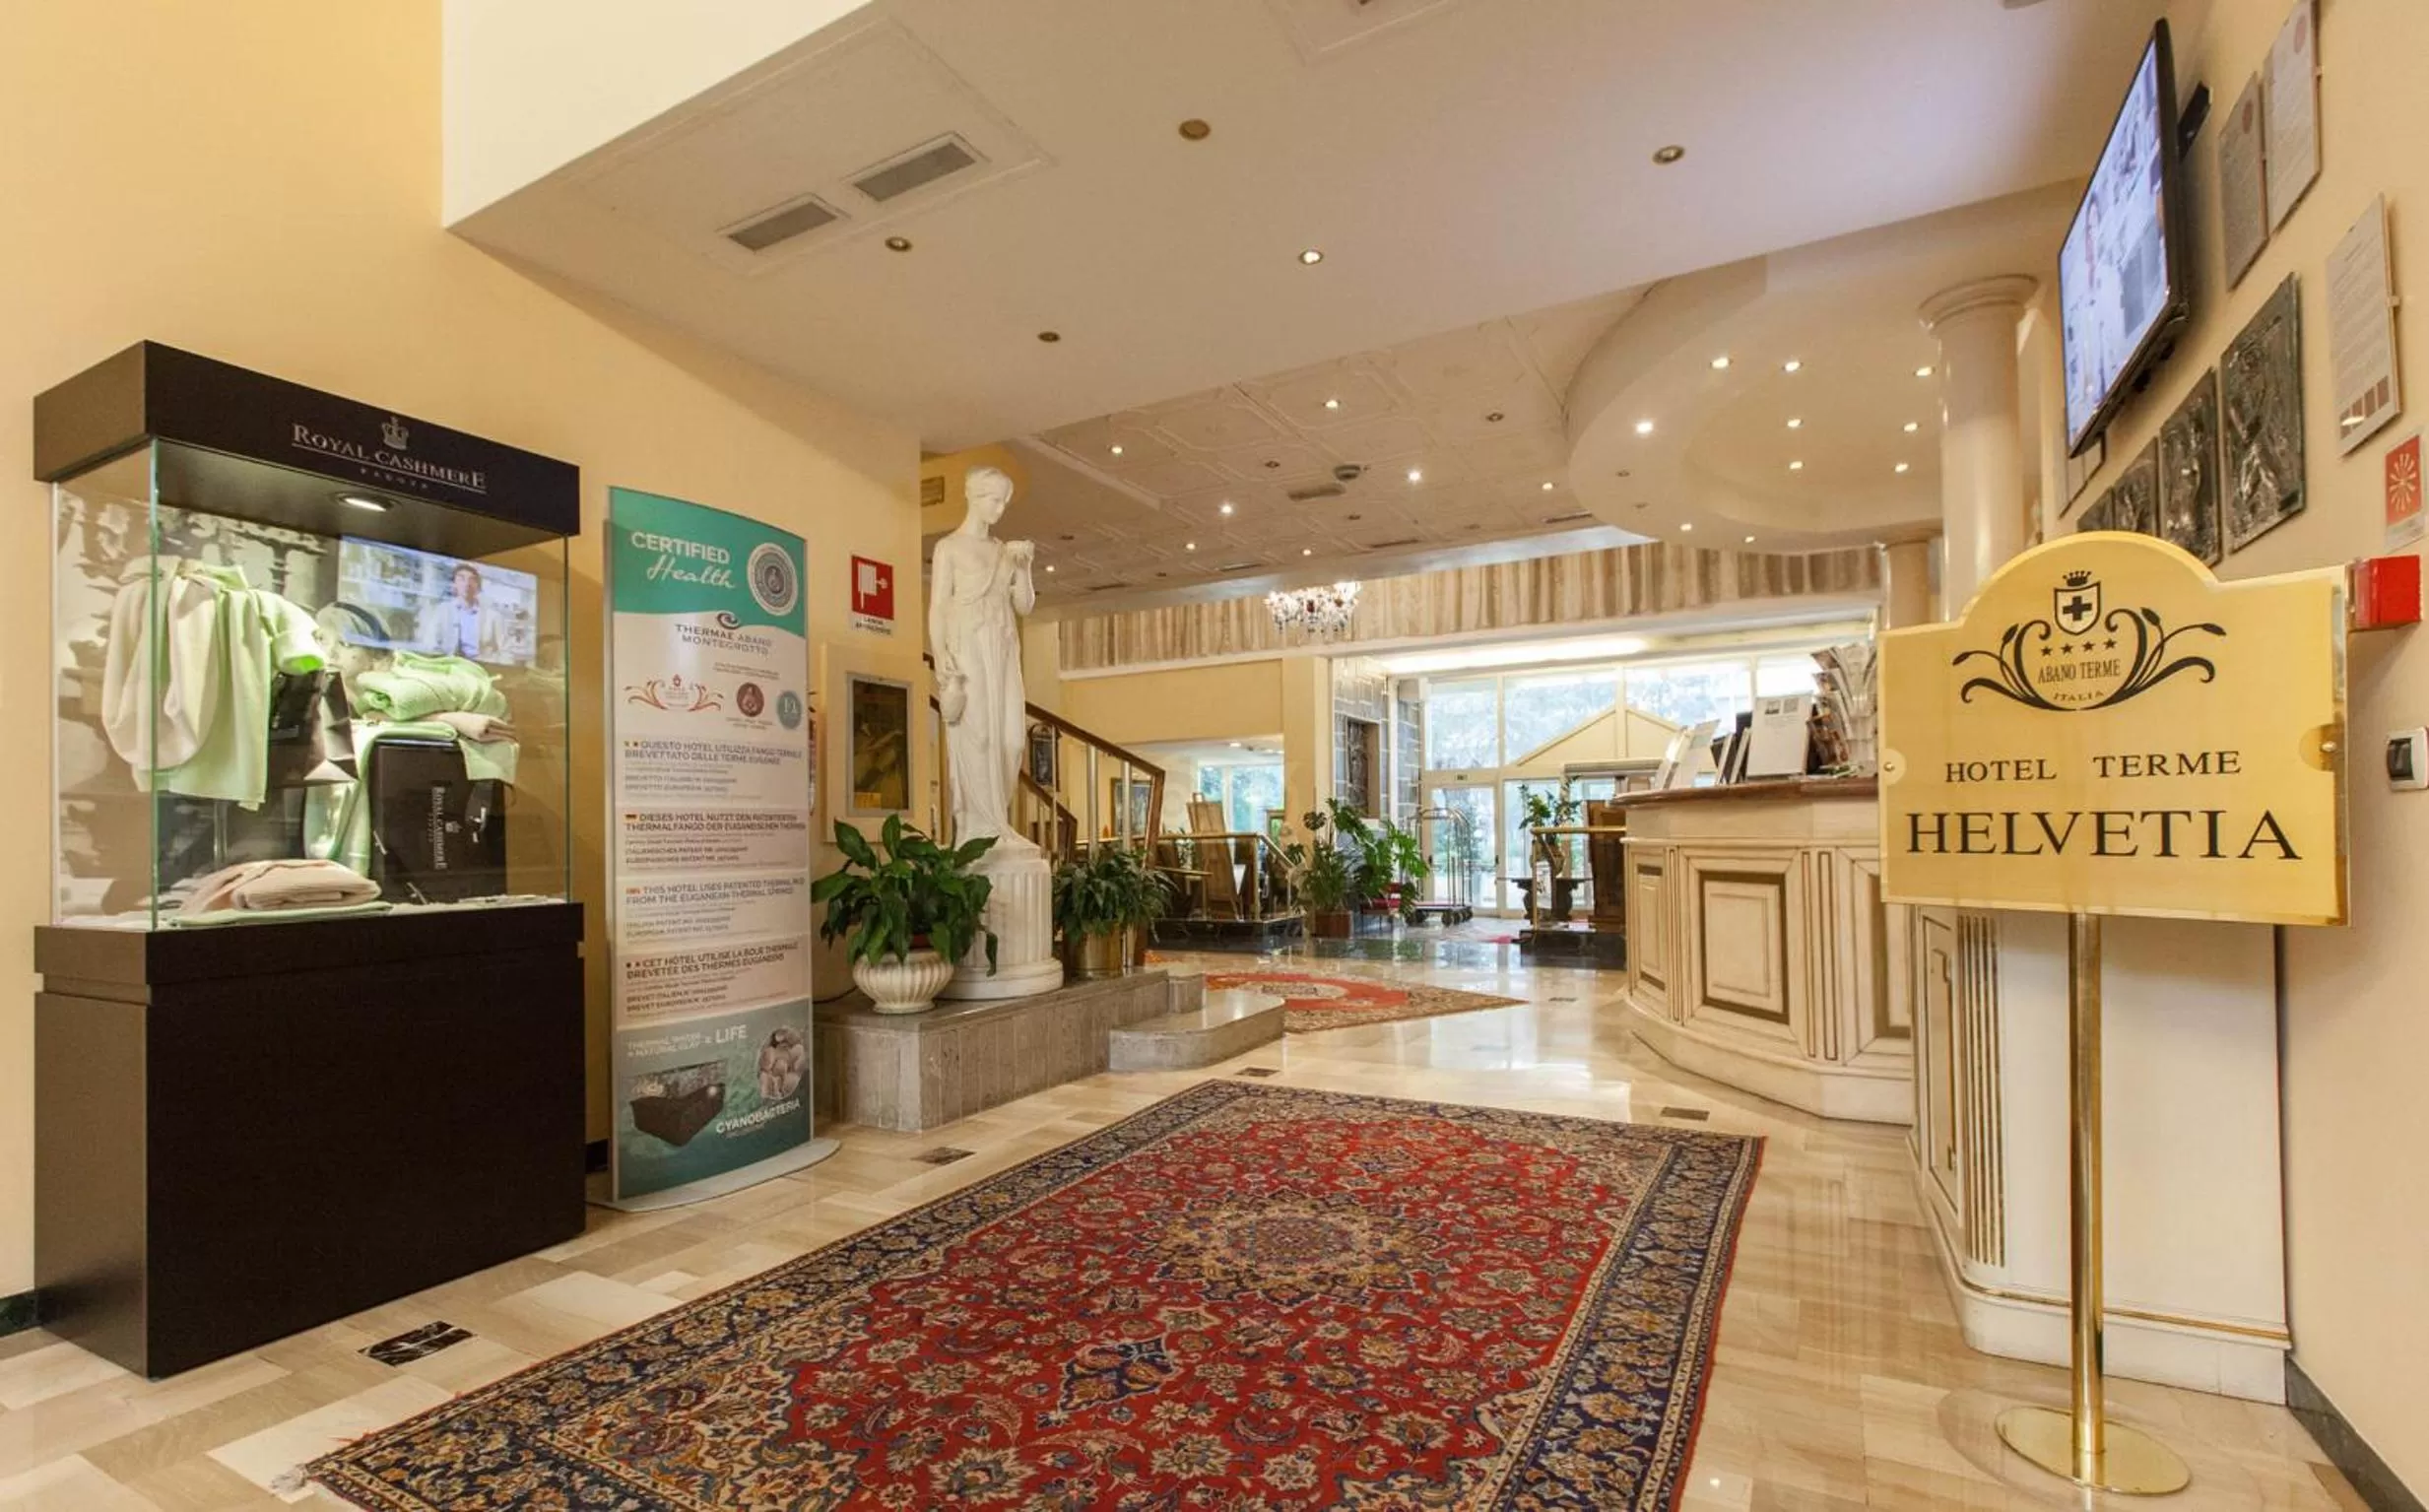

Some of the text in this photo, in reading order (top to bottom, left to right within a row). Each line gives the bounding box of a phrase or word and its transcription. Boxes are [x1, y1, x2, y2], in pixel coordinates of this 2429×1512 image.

[292, 424, 487, 490] ROYAL CASHMERE
[631, 532, 730, 564] CERTIFIED
[646, 554, 737, 589] Health
[674, 624, 735, 640] THERMAE
[2038, 658, 2121, 684] ABANO TERME
[2053, 690, 2105, 702] ITALIA
[1945, 750, 2242, 783] HOTEL TERME
[1906, 809, 2303, 861] HELVETIA
[625, 895, 656, 906] FROM
[660, 894, 678, 903] THE
[642, 958, 662, 968] CET
[715, 1023, 749, 1044] LIFE
